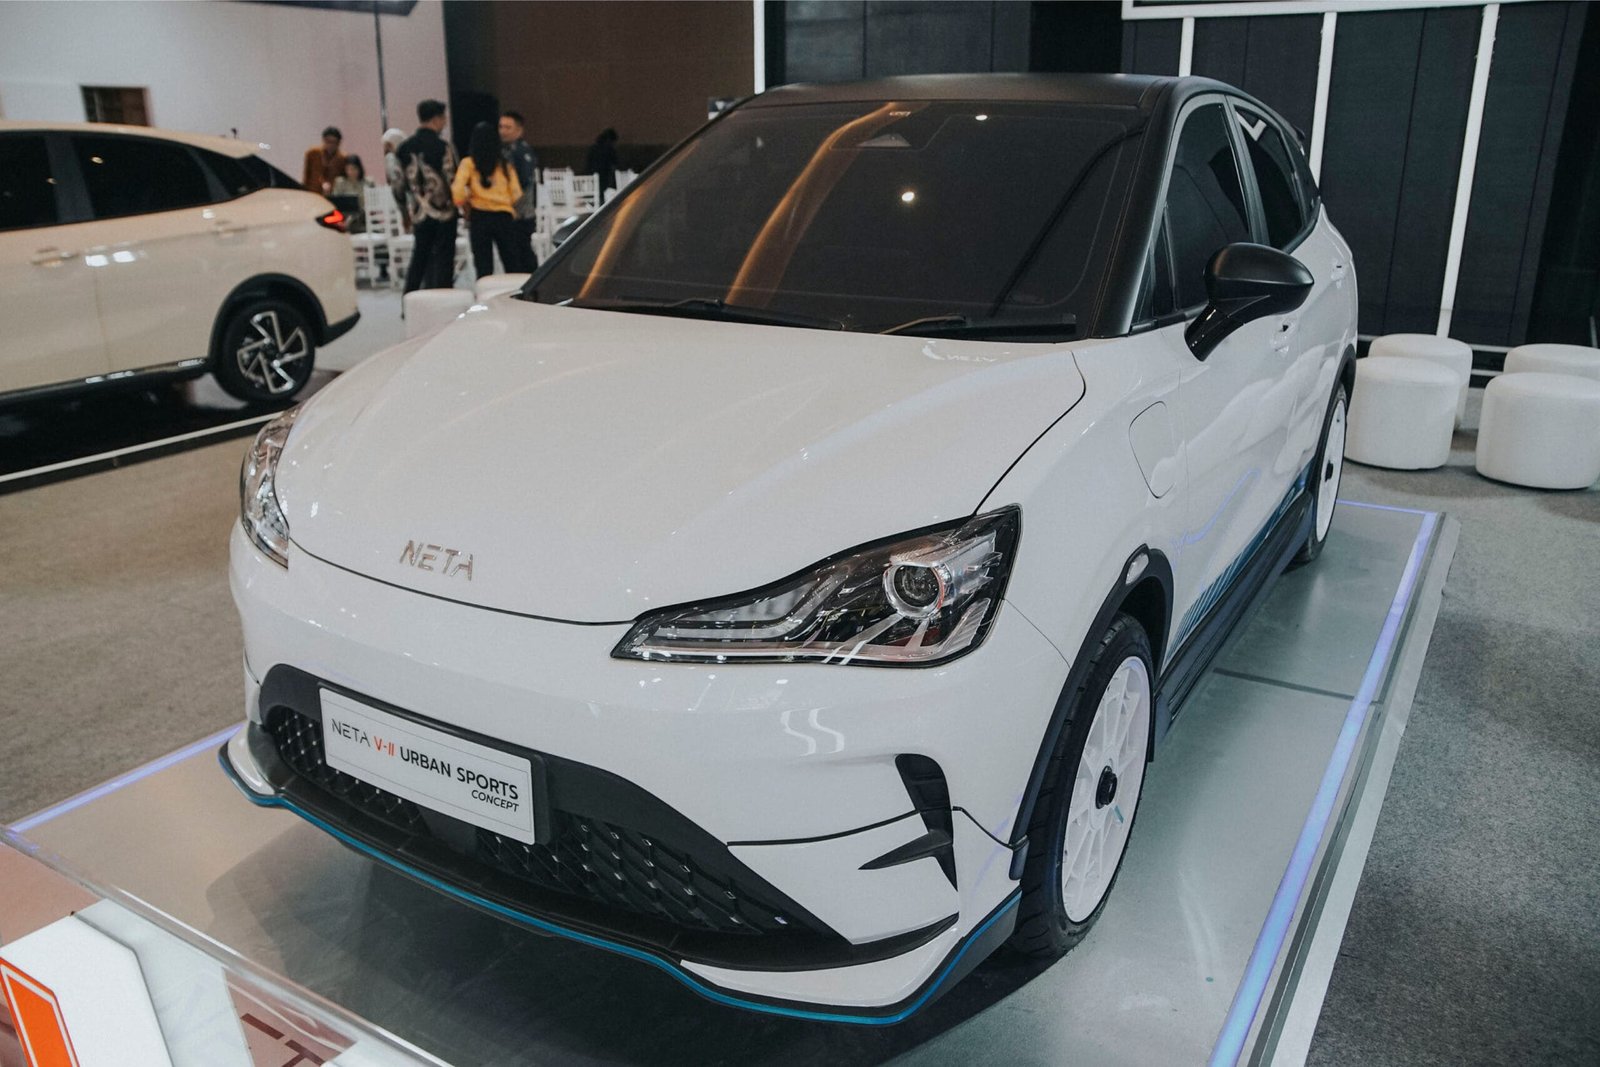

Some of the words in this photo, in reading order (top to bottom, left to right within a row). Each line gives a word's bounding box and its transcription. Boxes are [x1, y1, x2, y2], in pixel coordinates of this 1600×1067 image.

[399, 540, 474, 581] NETA
[331, 718, 371, 748] NETA
[400, 746, 451, 778] URBAN
[456, 767, 519, 800] SPORTS
[471, 789, 520, 813] CONCEPT
